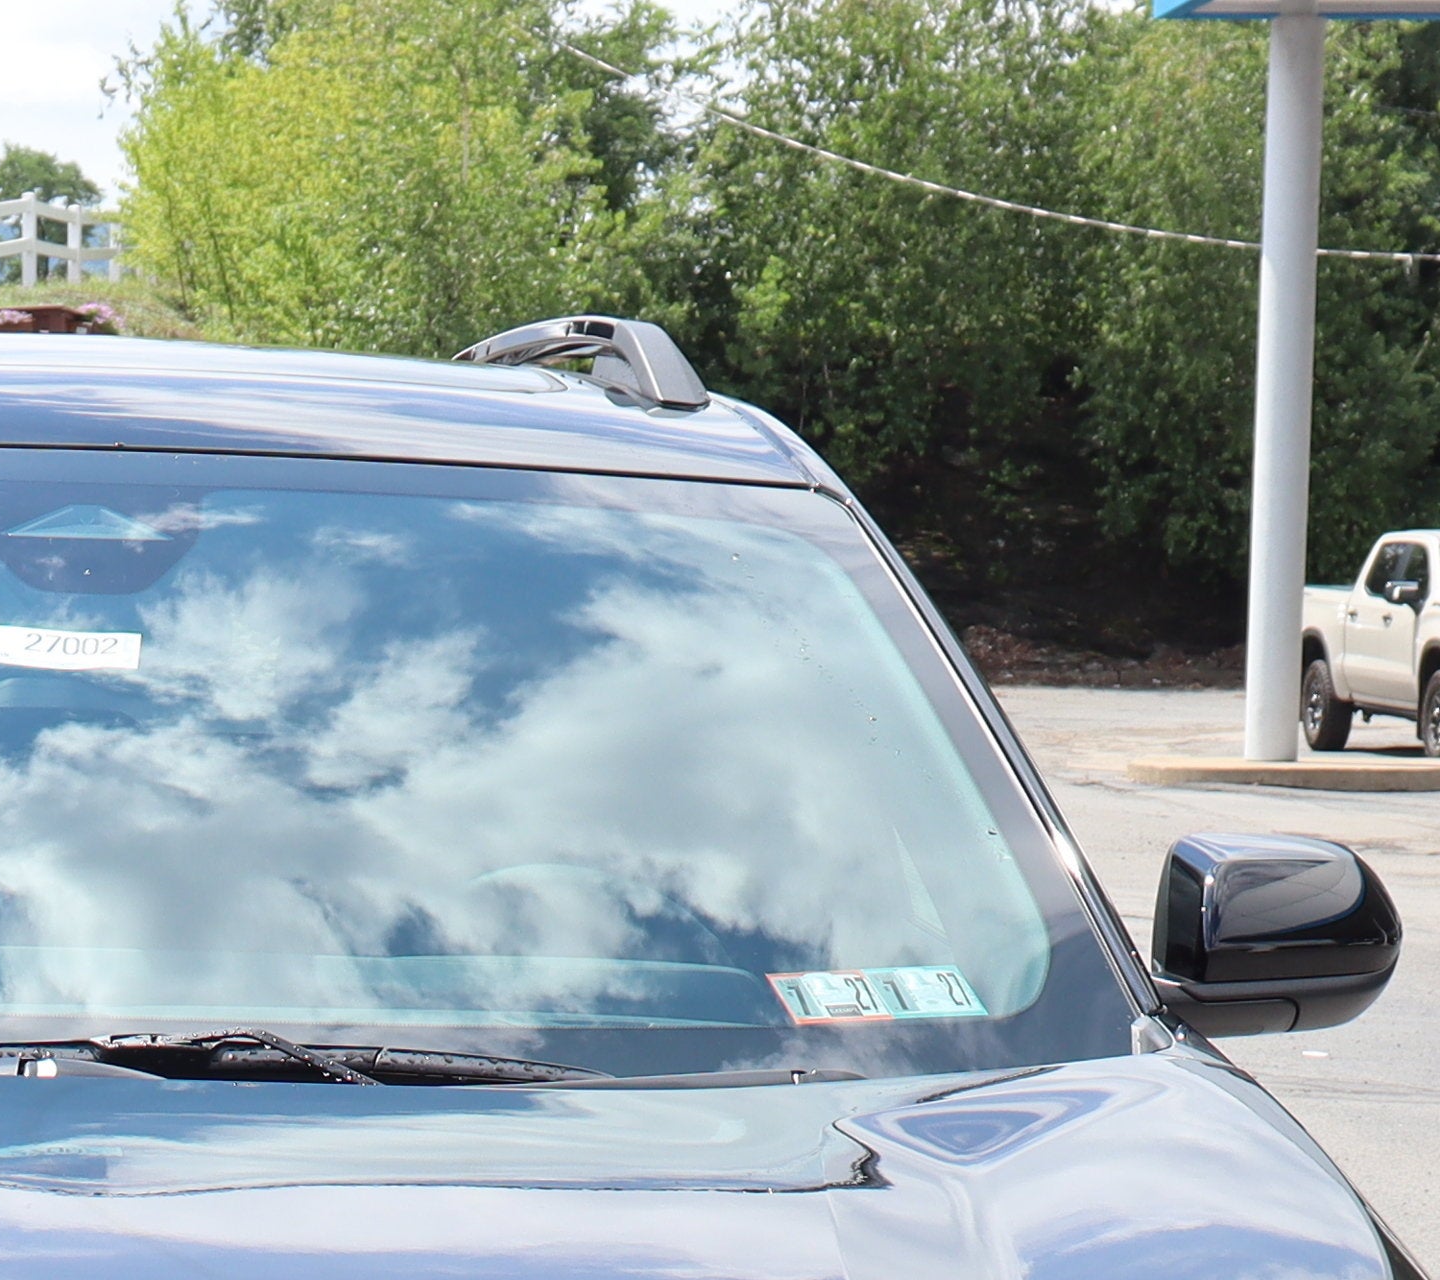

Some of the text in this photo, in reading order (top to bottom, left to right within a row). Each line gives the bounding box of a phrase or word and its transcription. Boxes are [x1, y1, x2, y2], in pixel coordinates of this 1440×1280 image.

[24, 632, 118, 656] 27002
[844, 976, 880, 1014] 27
[936, 972, 972, 1008] 27
